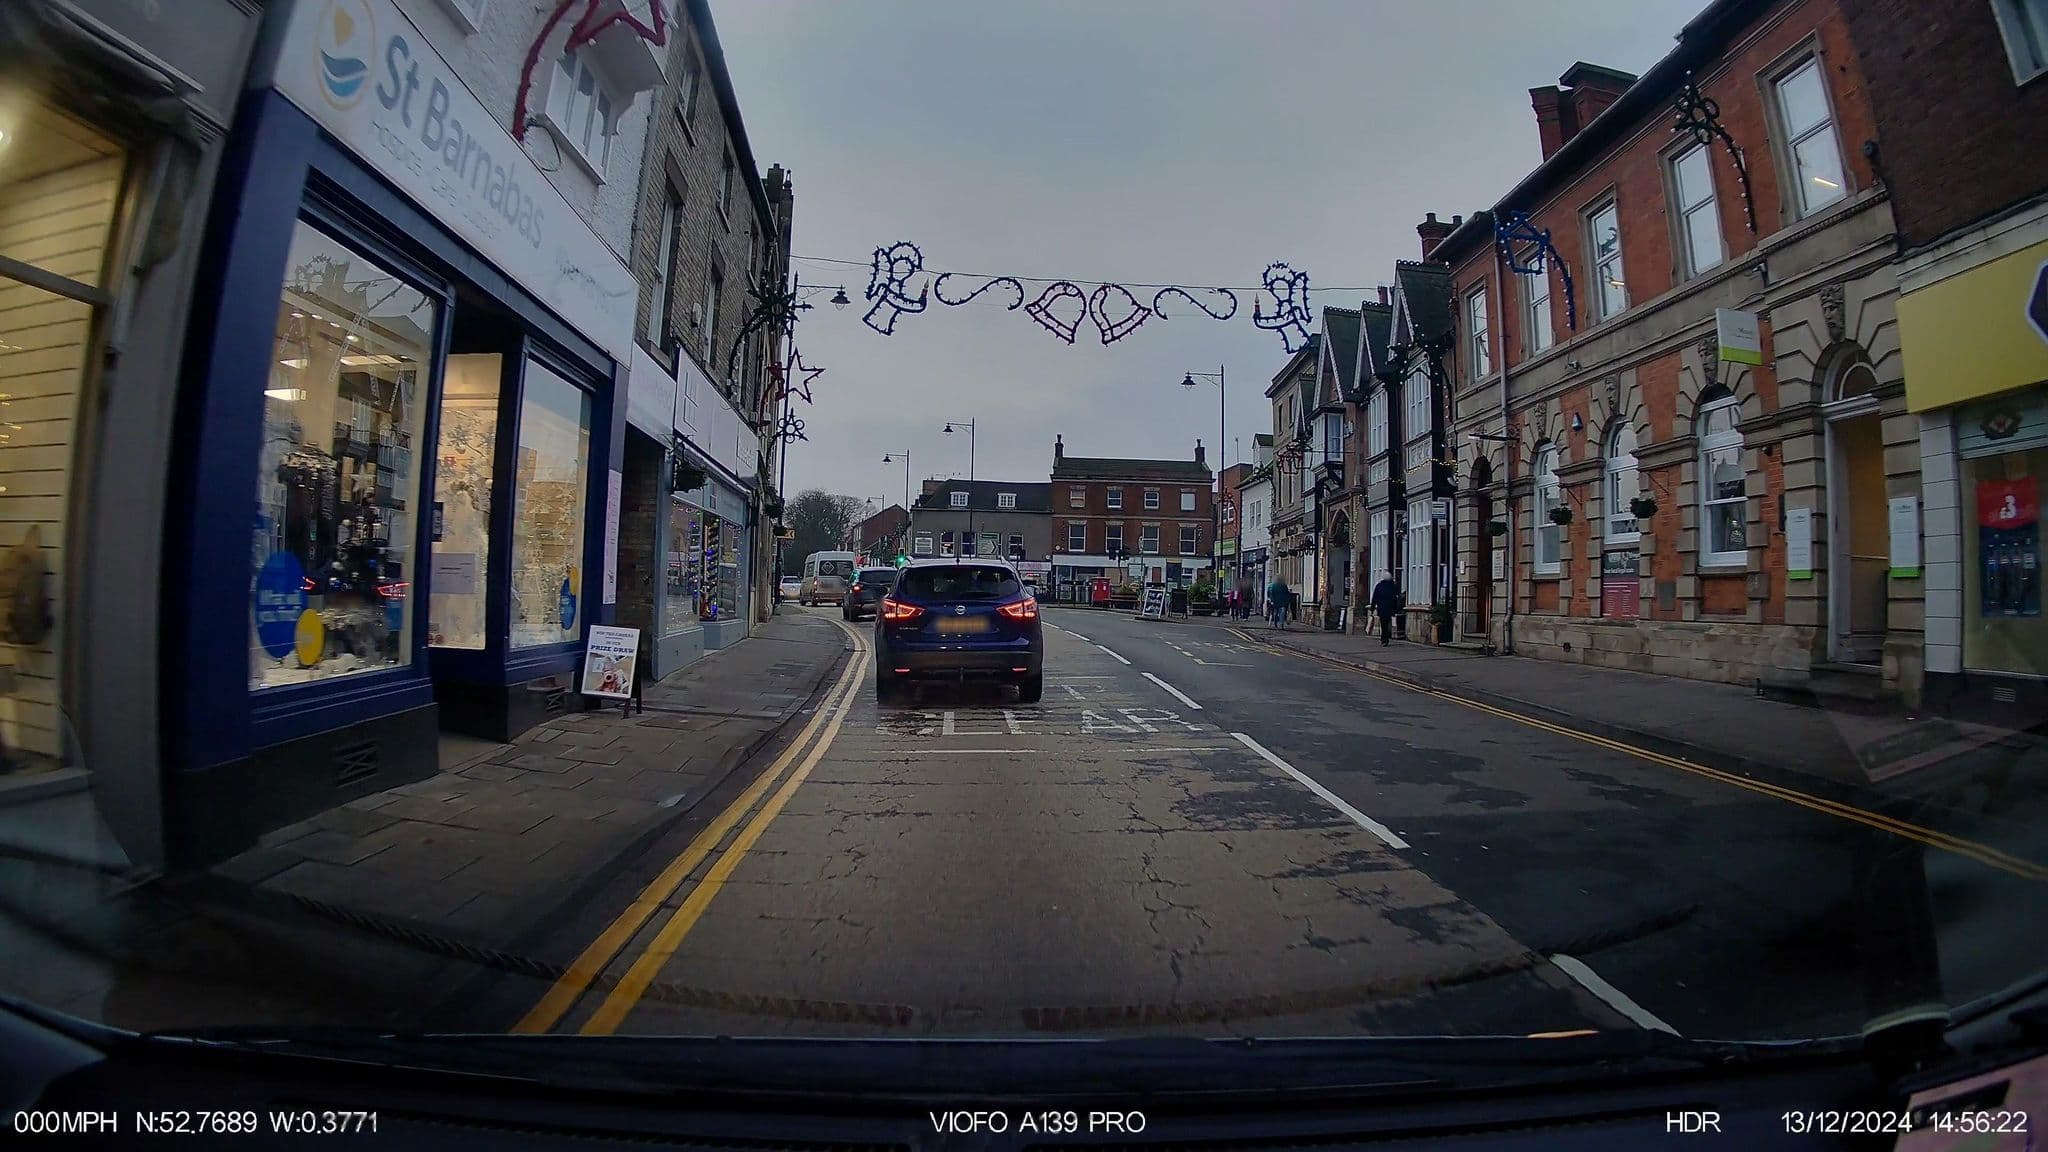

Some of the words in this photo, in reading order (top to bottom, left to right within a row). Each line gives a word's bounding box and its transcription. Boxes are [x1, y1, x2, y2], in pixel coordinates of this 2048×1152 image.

[375, 34, 421, 129] St
[420, 76, 545, 249] Barnabas
[590, 644, 612, 652] PRIZE
